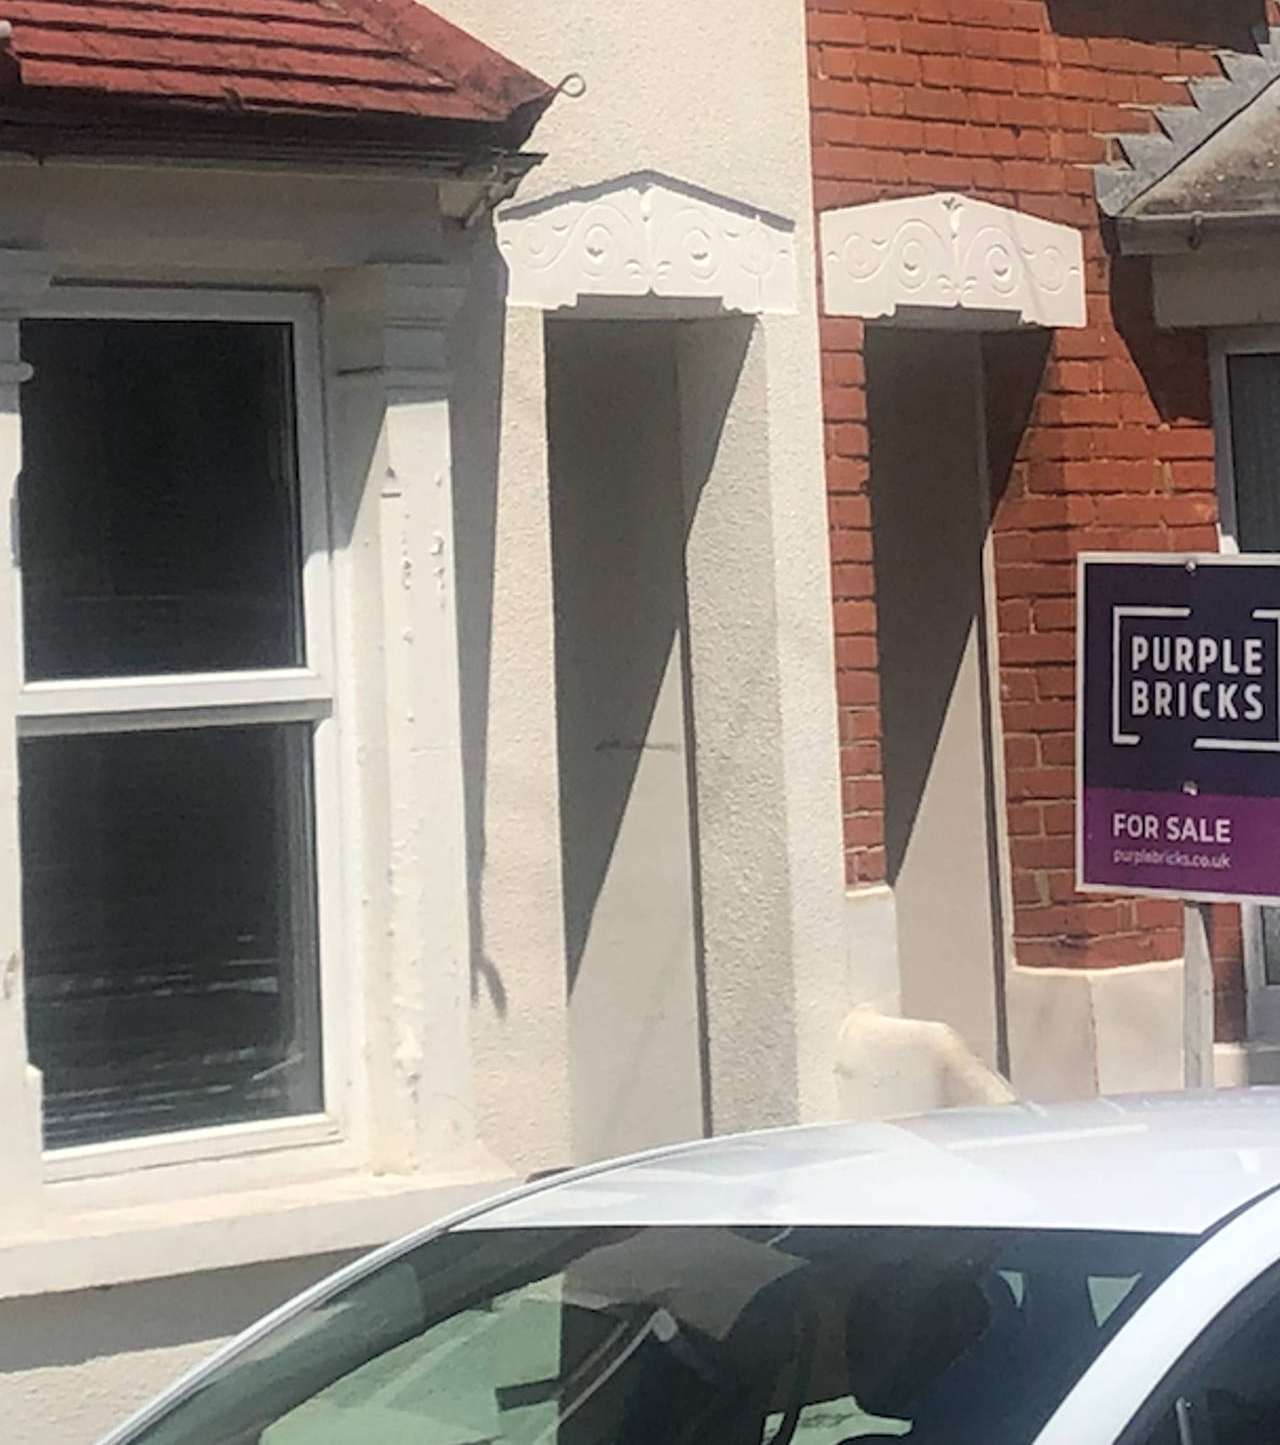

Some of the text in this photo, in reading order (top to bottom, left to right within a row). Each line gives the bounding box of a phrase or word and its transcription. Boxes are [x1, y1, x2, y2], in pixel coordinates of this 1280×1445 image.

[1131, 636, 1263, 674] PURPLE
[1131, 681, 1264, 720] BRICKS
[1113, 813, 1231, 843] FOR SALE
[1113, 848, 1231, 868] purplebricks.co.uk
